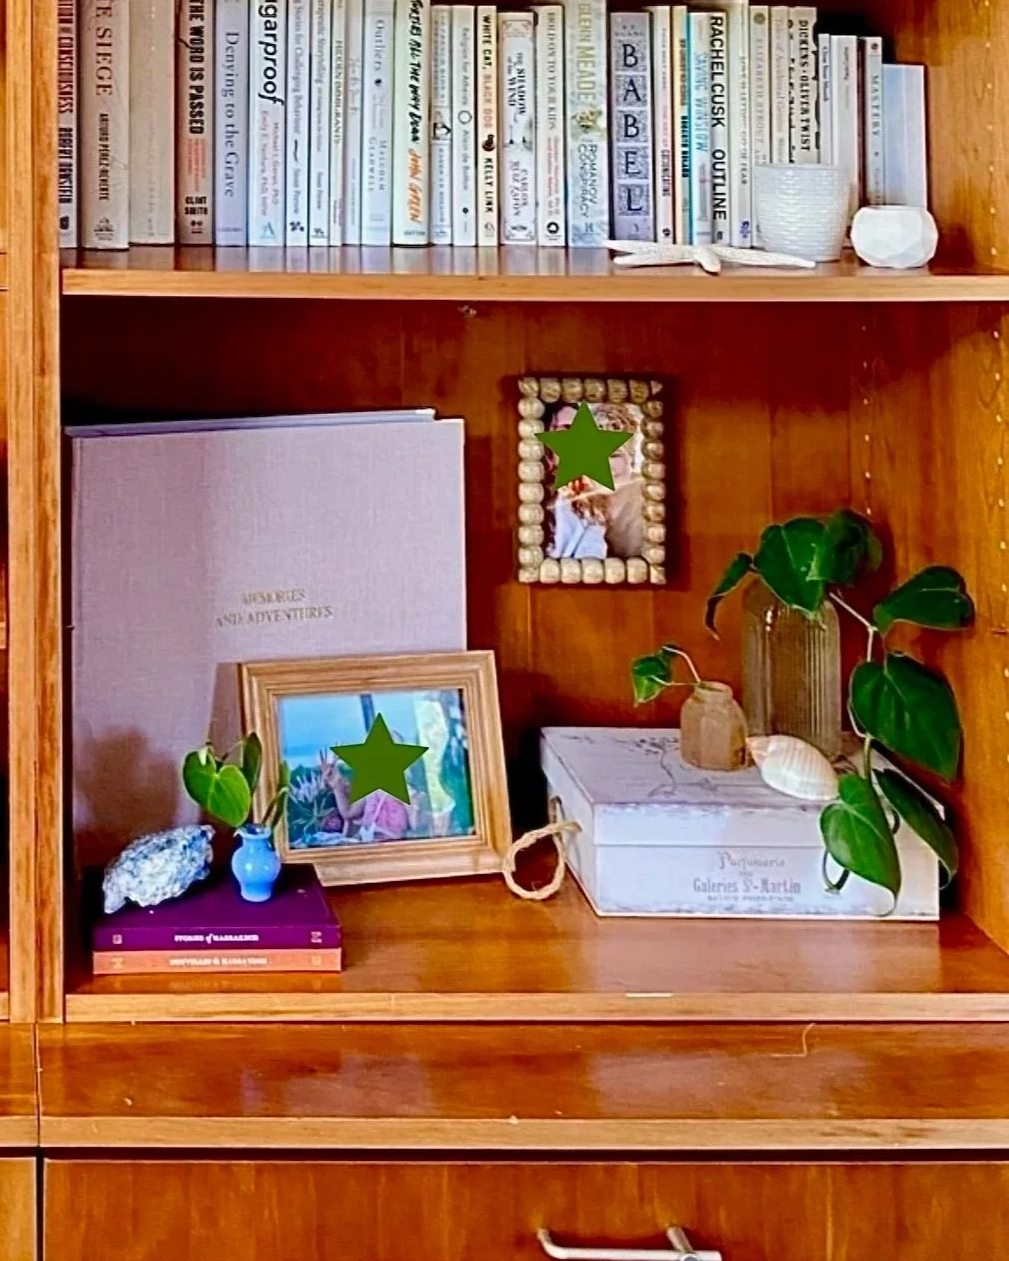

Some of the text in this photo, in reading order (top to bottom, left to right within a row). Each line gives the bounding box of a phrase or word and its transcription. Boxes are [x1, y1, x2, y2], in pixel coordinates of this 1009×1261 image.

[291, 5, 303, 30] Stories
[291, 33, 303, 45] for
[547, 12, 557, 67] HOLD ON TO
[95, 27, 113, 97] SIEGE
[189, 26, 204, 62] WORD
[315, 38, 327, 84] Storytelling
[373, 19, 385, 71] Outliers
[409, 39, 423, 59] ALL
[577, 3, 595, 99] GLENN MEADE
[799, 20, 809, 67] DICKENS
[189, 67, 204, 81] IS
[291, 47, 303, 92] Challenging
[409, 62, 423, 81] THE
[481, 15, 491, 129] WHITE CAT, BLACK DOG
[507, 77, 517, 107] WIND
[515, 68, 526, 115] SHADOW
[710, 16, 726, 127] RACHEL CUSK
[189, 85, 204, 134] PASSED
[223, 32, 239, 197] Denying to the Grave
[623, 43, 643, 212] BABEL
[799, 75, 809, 151] OLIVER TWIST
[871, 75, 879, 137] MASTERY
[484, 157, 494, 213] KELLY LINK
[579, 143, 589, 218] CONSPIRACY
[589, 144, 597, 204] ROMANOV
[711, 149, 726, 220] OUTLINE
[409, 183, 422, 224] GREEN
[215, 606, 333, 627] AND ADVENTURES
[693, 877, 737, 893] Galeries
